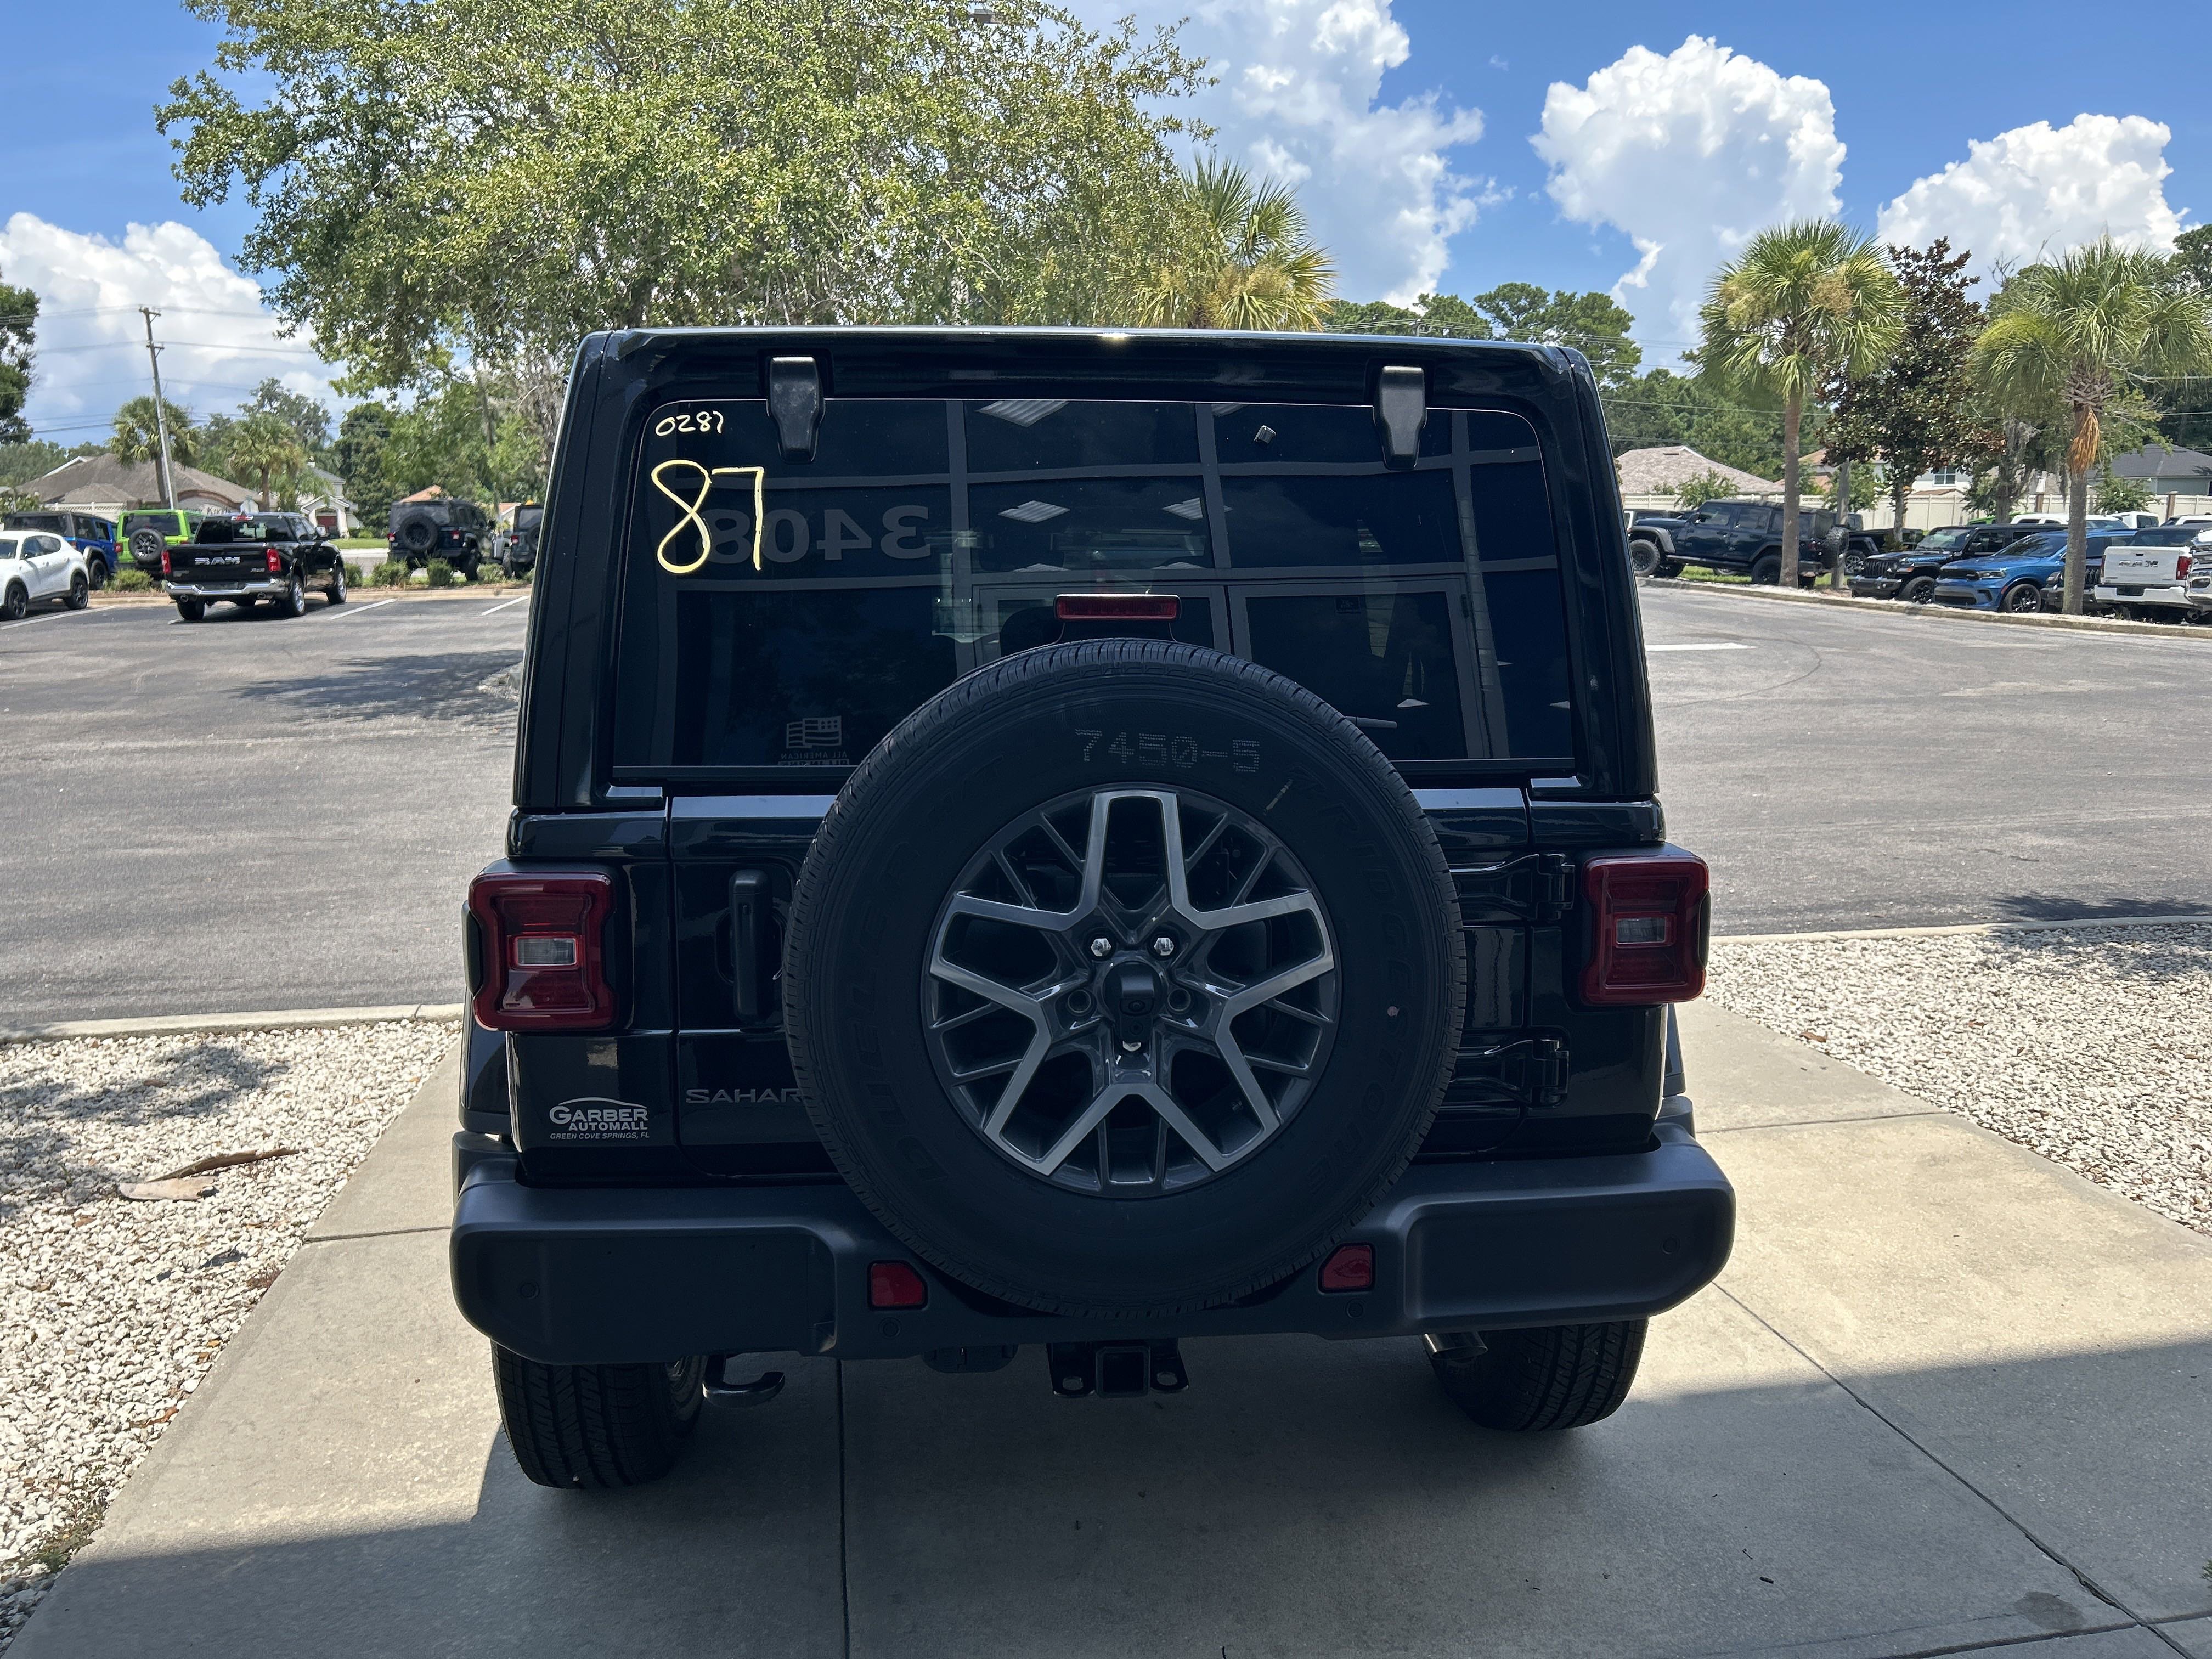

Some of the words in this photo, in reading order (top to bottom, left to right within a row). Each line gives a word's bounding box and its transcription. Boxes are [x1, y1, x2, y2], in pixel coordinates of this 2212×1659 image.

[651, 459, 764, 574] 87
[195, 556, 240, 565] RAM
[2119, 559, 2159, 568] RAM
[1075, 729, 1260, 772] 7450-5
[686, 1088, 803, 1104] SAHAR
[549, 1105, 648, 1125] GARBER
[568, 1121, 648, 1131] AUTOMALL
